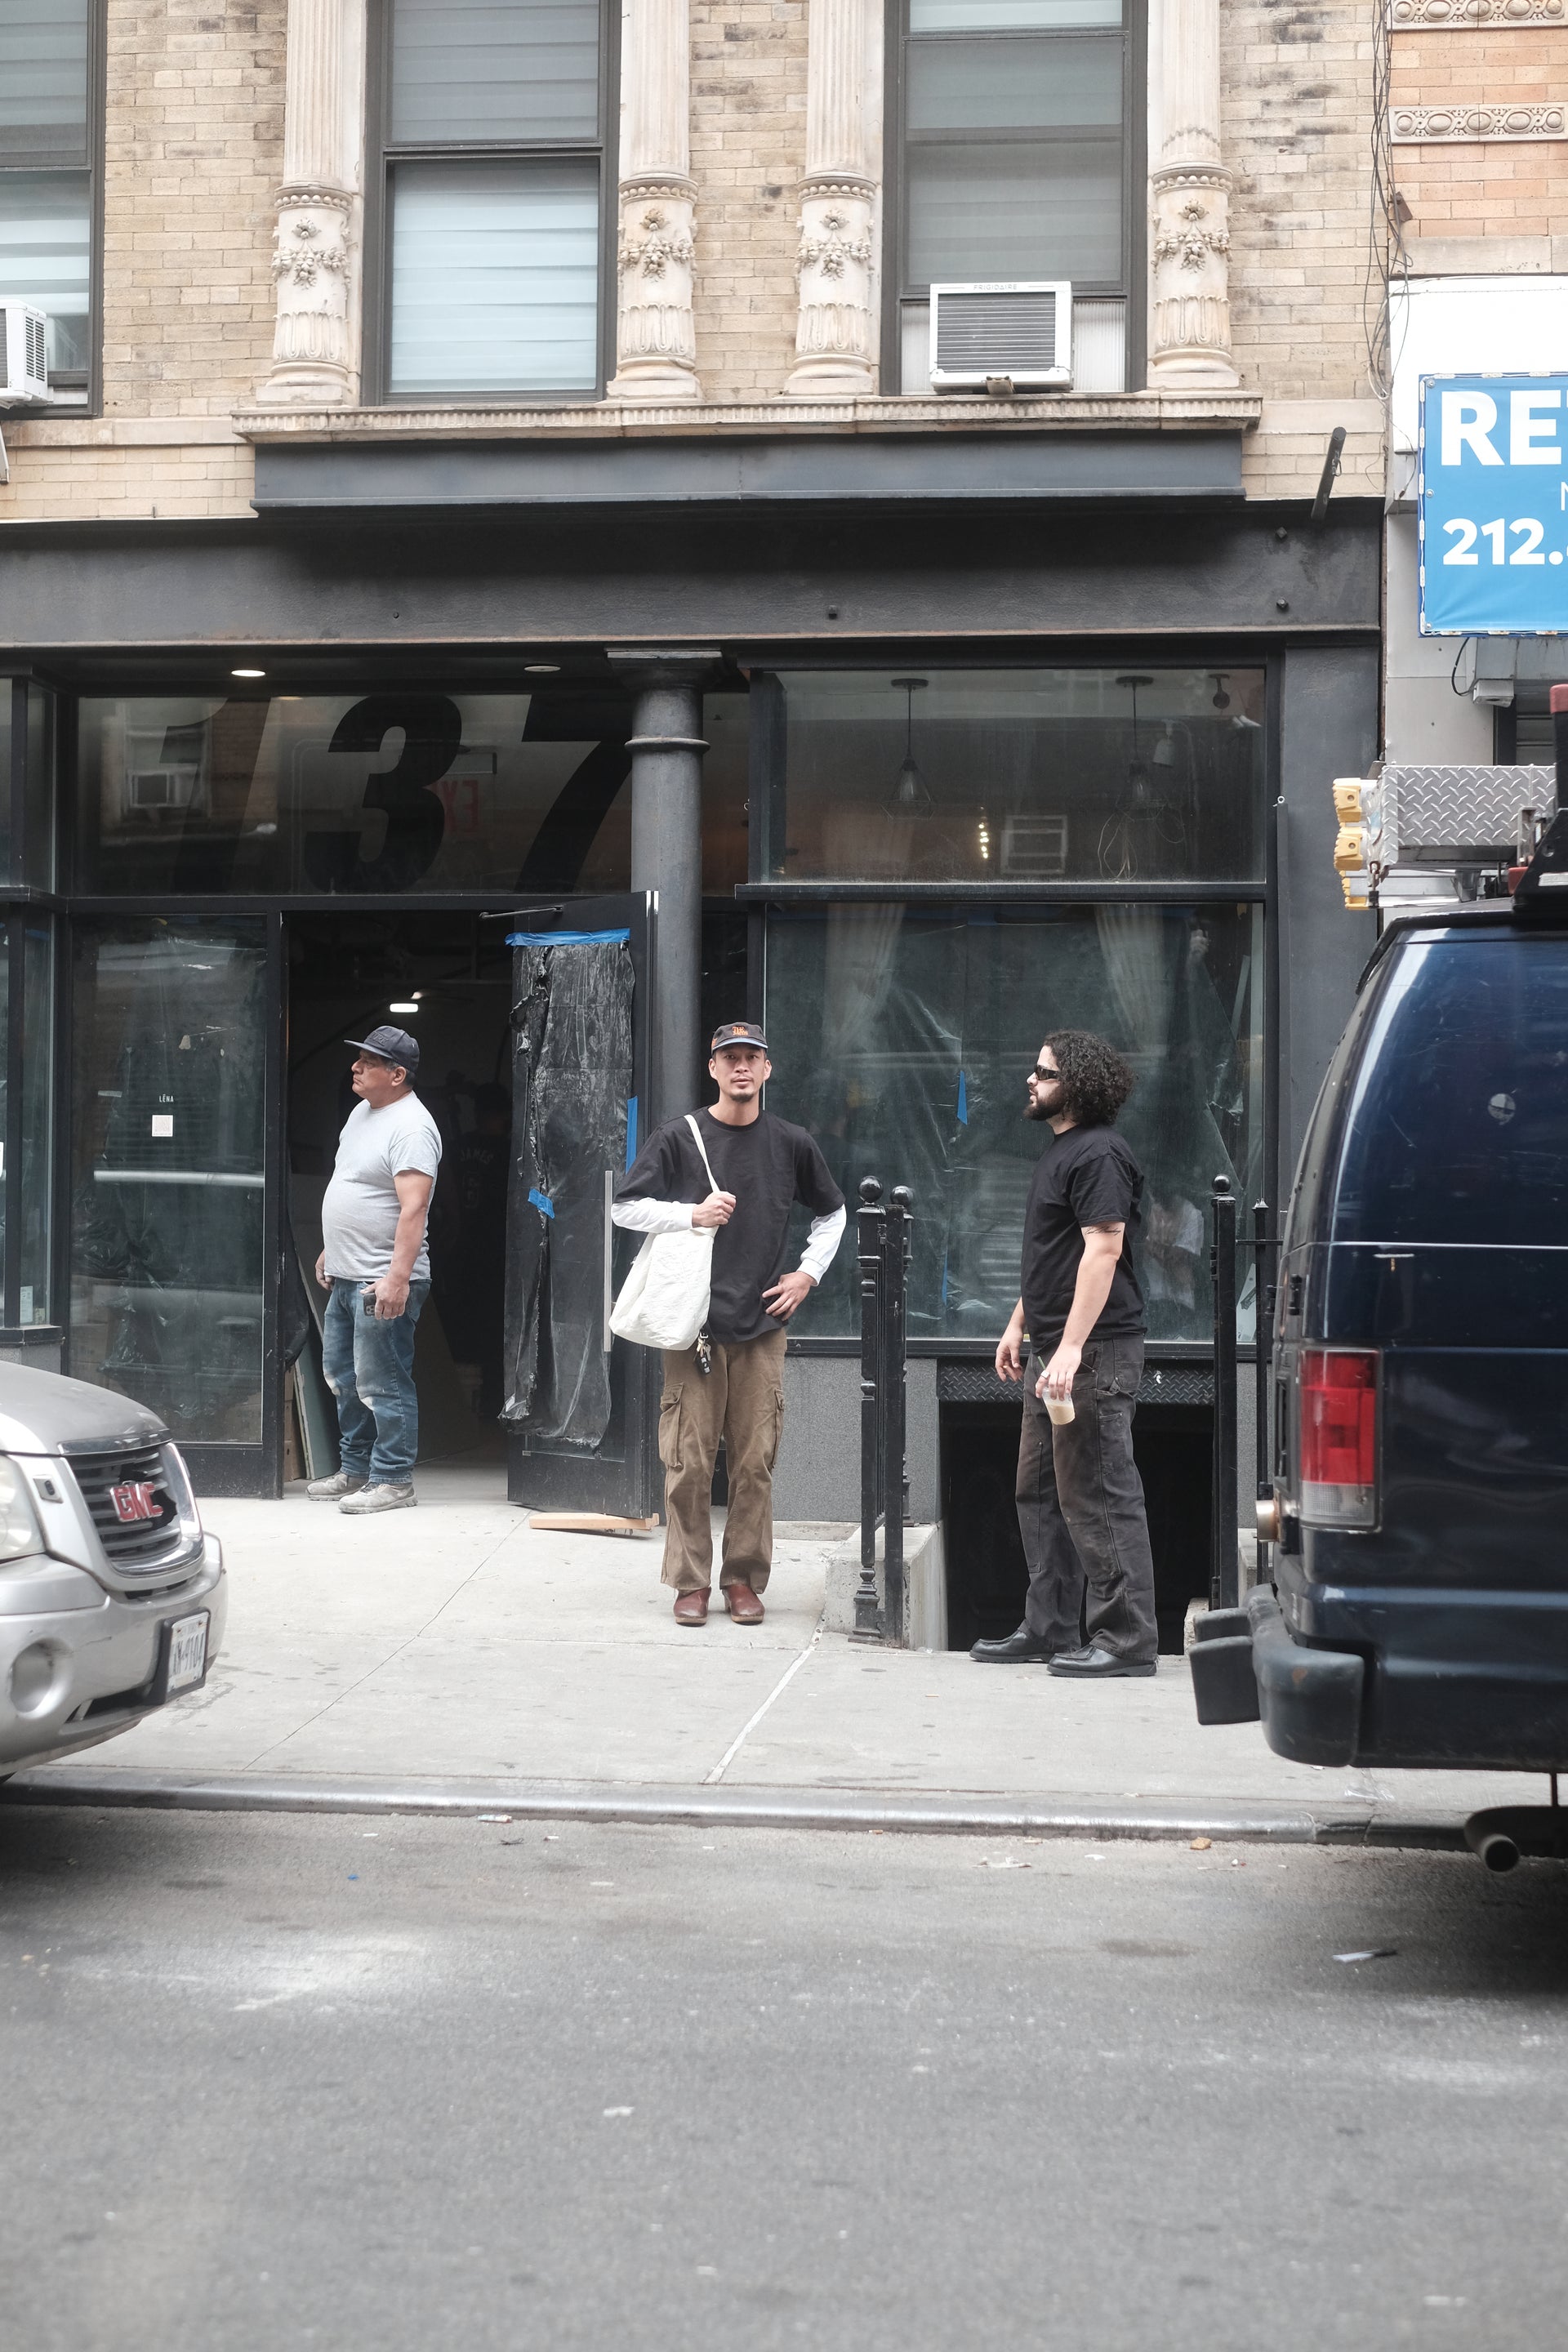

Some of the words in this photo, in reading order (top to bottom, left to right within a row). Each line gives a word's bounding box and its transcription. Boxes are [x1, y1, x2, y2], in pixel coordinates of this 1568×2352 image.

[1441, 390, 1568, 466] RE
[1442, 517, 1568, 566] 212.
[160, 694, 632, 893] 137
[460, 1147, 494, 1165] JAMES
[109, 1481, 163, 1523] GMC
